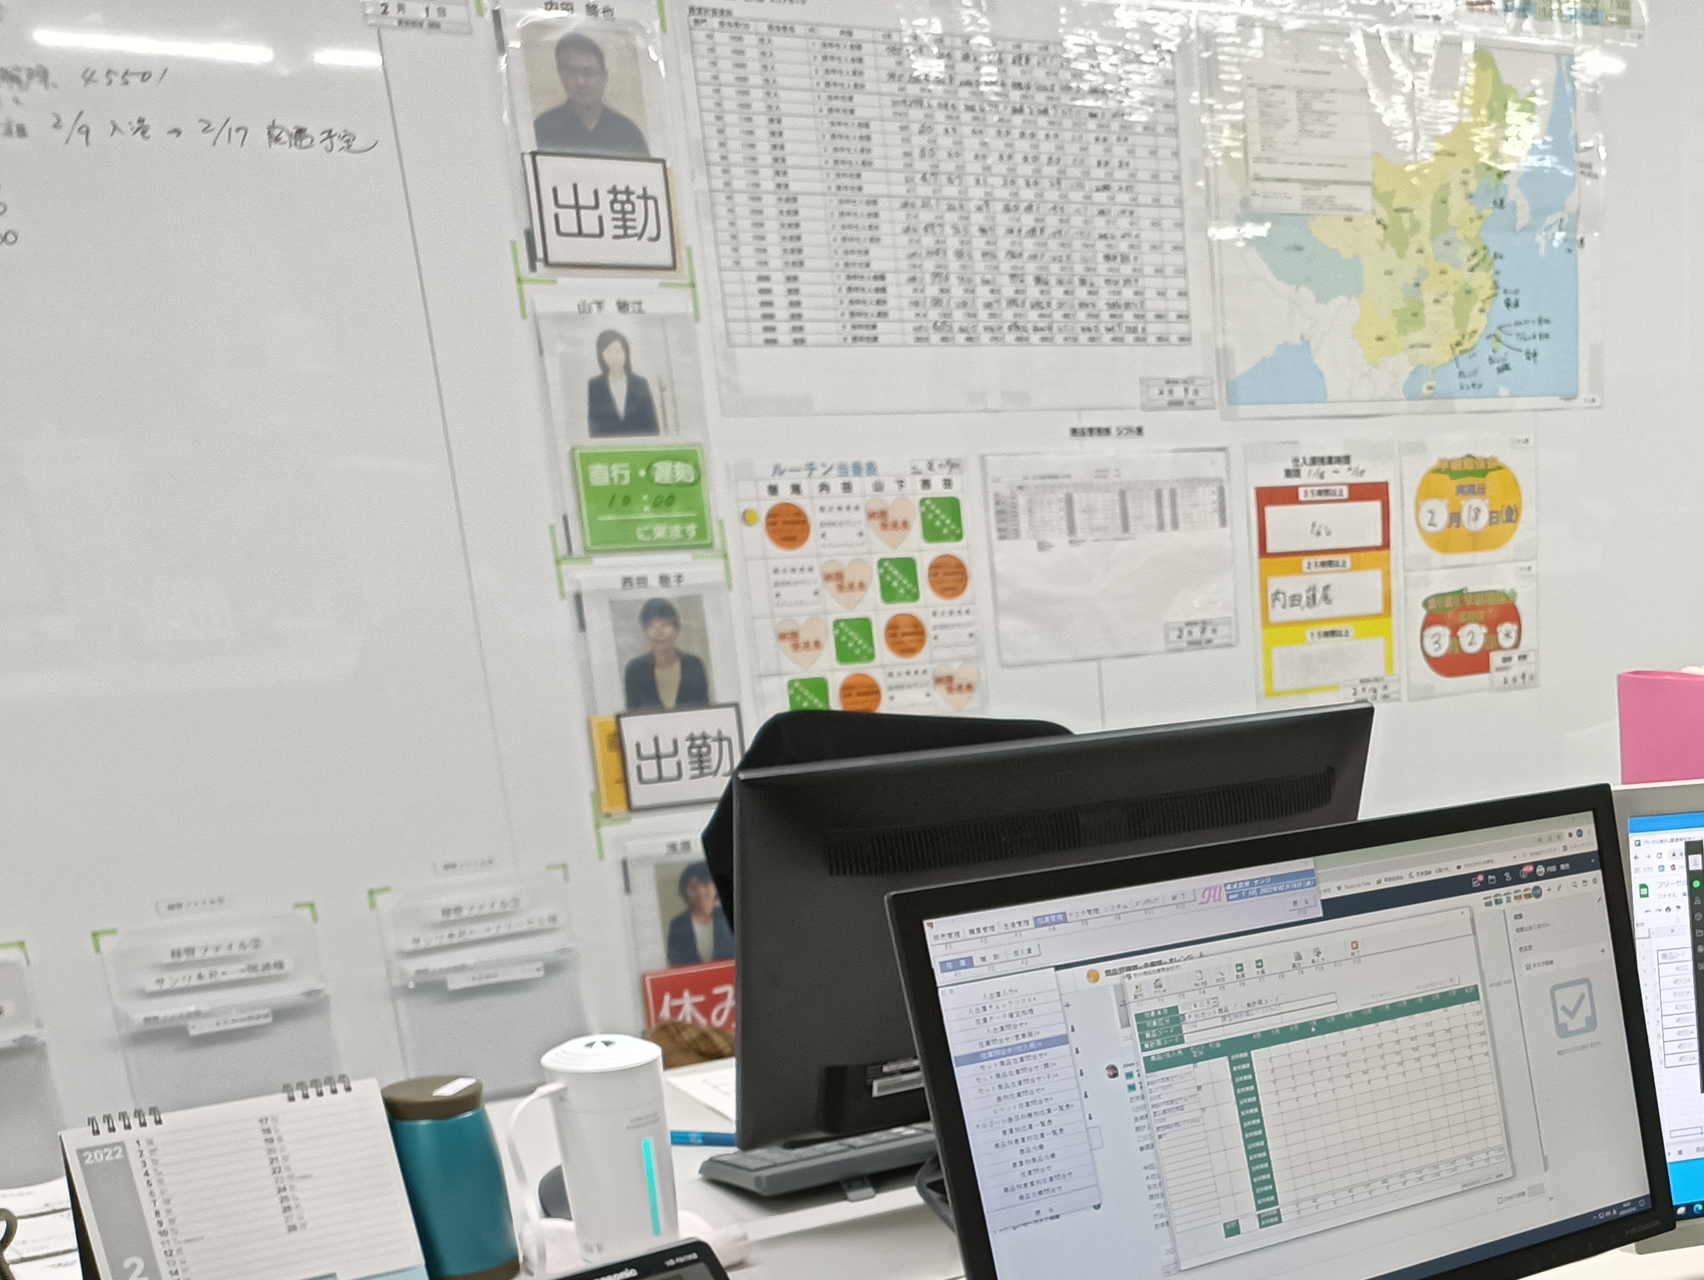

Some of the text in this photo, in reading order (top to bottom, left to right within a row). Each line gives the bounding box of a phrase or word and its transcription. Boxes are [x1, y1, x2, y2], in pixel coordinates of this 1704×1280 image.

[552, 184, 661, 242] 出勤
[636, 728, 735, 785] 出勤
[83, 1146, 126, 1165] 2022
